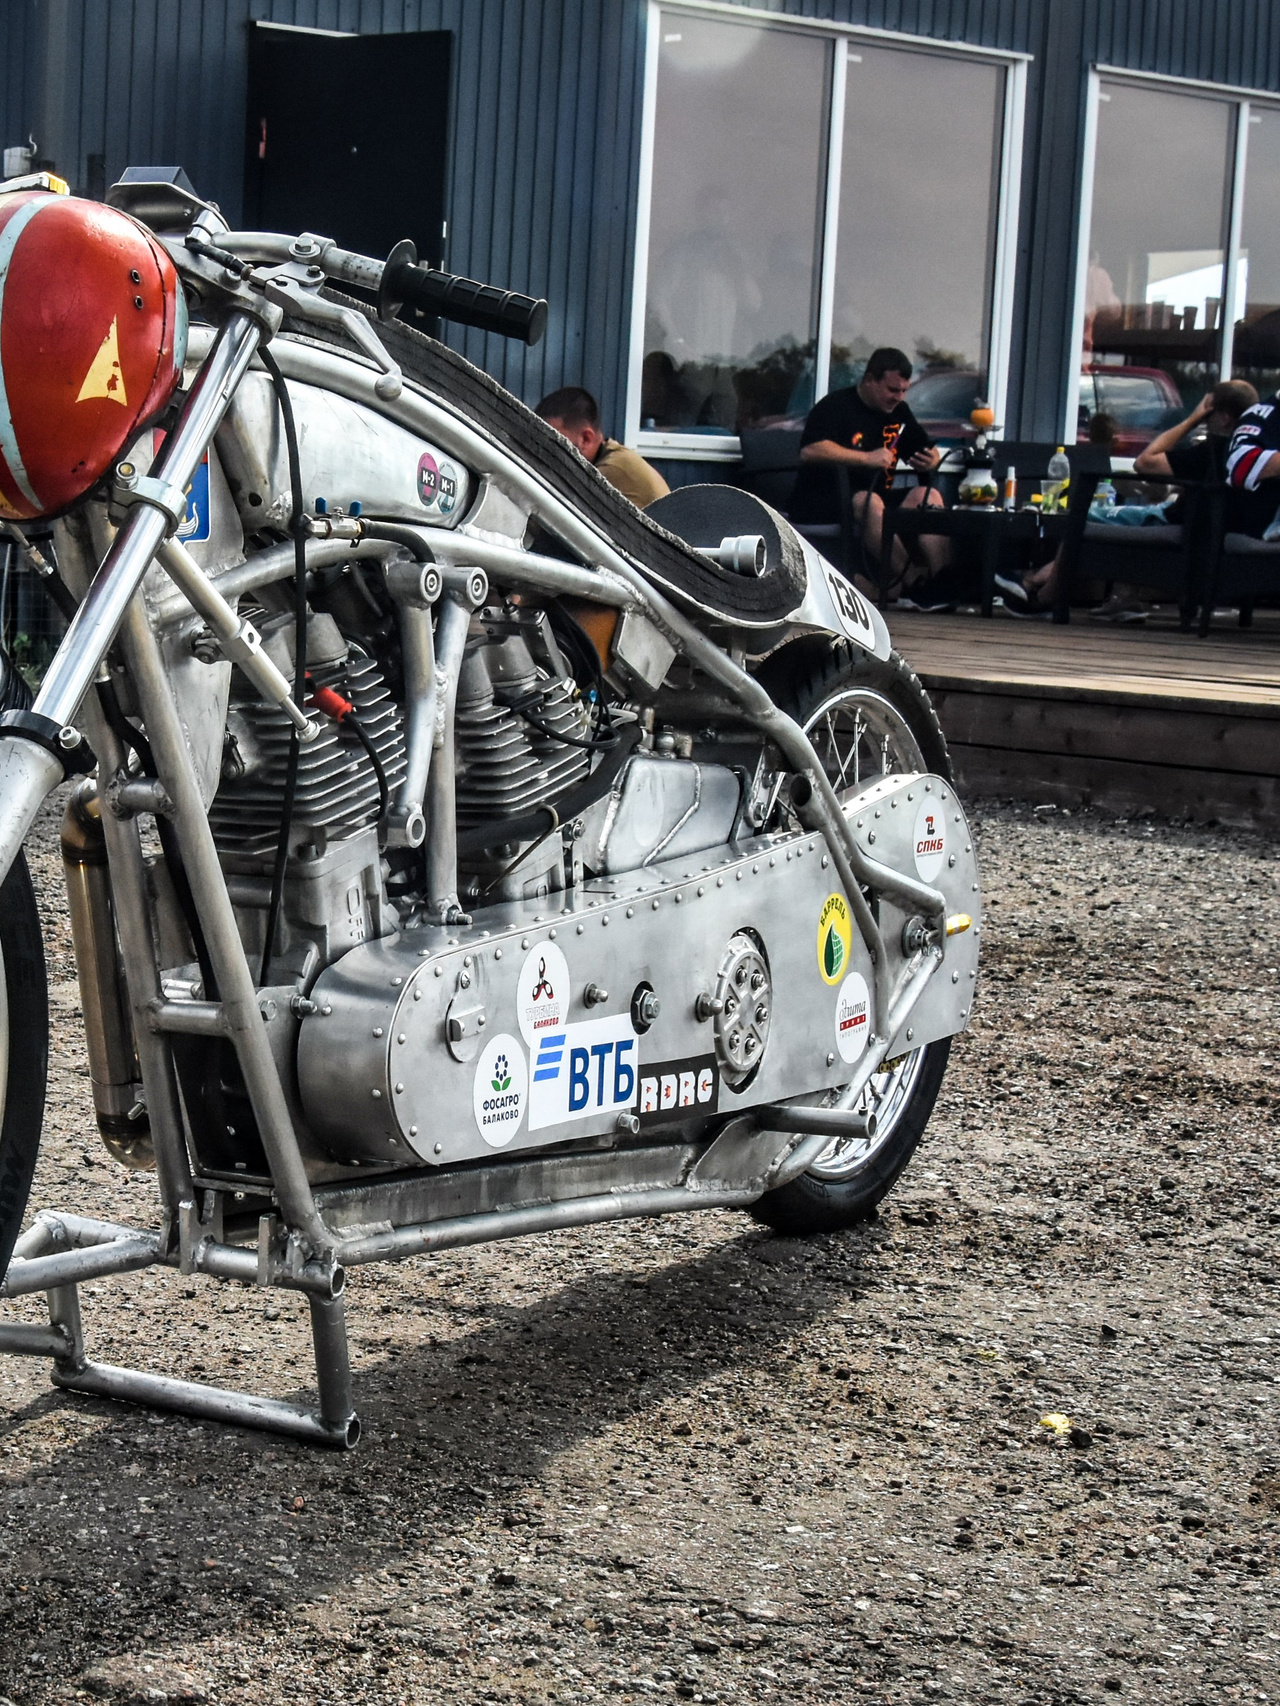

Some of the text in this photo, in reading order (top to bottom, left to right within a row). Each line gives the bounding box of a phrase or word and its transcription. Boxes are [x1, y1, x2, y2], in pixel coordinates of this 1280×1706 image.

[828, 572, 870, 631] 130
[916, 838, 944, 854] СПКБ
[820, 897, 846, 927] БАРРЕЛЬ
[568, 1039, 635, 1112] ВТБ
[640, 1068, 713, 1113] RDRC
[483, 1094, 519, 1111] ФОСАГРО
[483, 1109, 519, 1125] БАЛАКОВО
